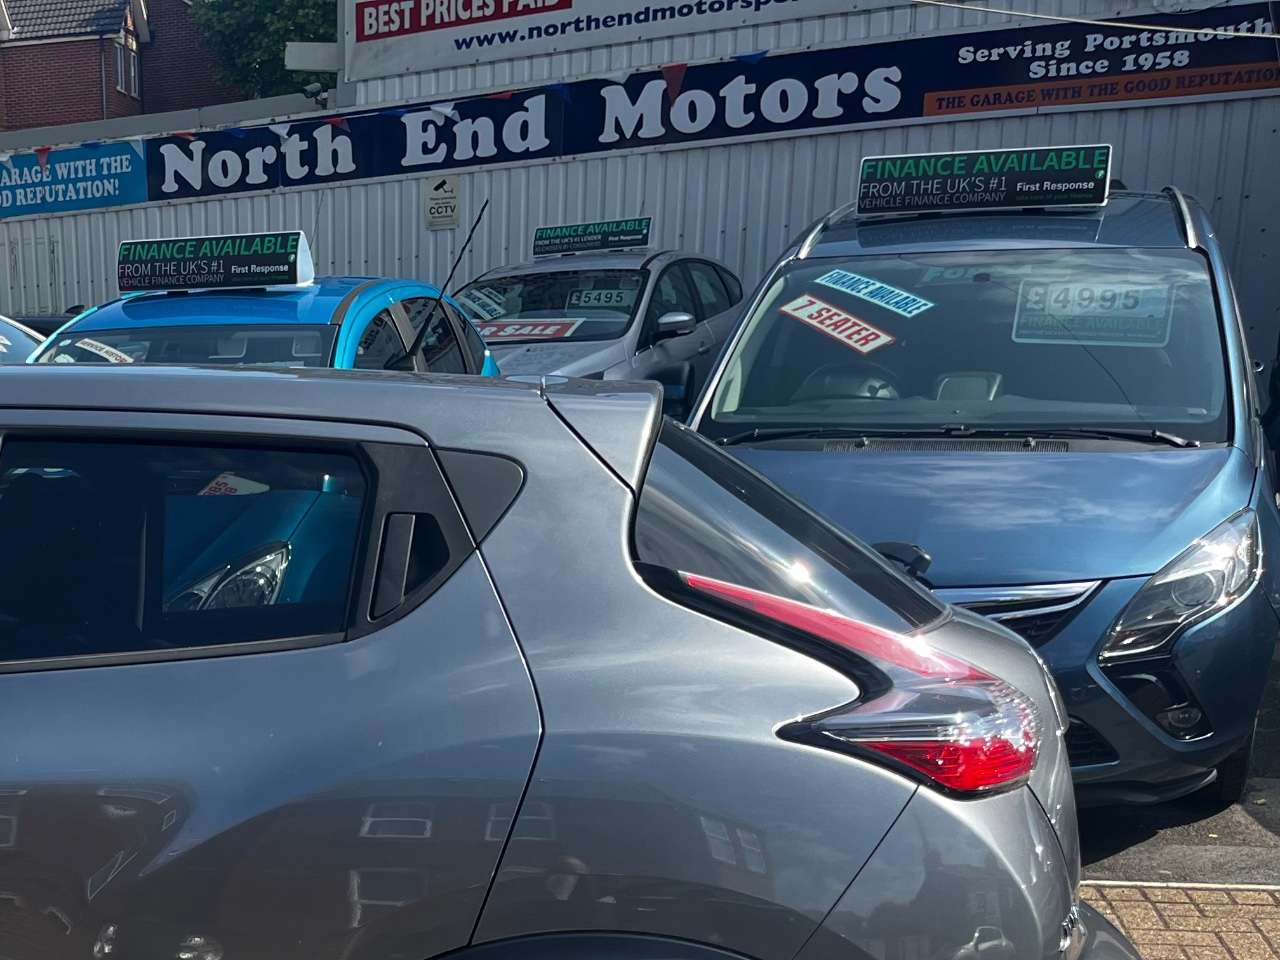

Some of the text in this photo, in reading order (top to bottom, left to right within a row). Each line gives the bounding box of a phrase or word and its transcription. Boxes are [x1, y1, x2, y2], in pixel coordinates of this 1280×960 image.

[363, 1, 415, 36] BEST
[420, 0, 495, 26] PRICES
[958, 17, 1273, 64] Serving Portsmouth
[1029, 50, 1190, 80] Since 1958
[936, 96, 966, 111] THE
[970, 91, 1036, 107] GARAGE
[1040, 86, 1084, 102] WITH
[1088, 83, 1119, 98] THE
[1124, 78, 1170, 95] GOOD
[160, 66, 902, 193] North End Motors
[55, 158, 97, 181] WITH
[100, 153, 132, 176] THE
[862, 148, 1108, 180] FINANCE AVAILABLE
[16, 178, 119, 207] REPUTATION!
[860, 176, 1007, 199] FROM THE UK'S #1
[860, 194, 902, 209] VEHICLE
[904, 192, 944, 207] FINANCE
[945, 190, 1007, 205] COMPANY
[1016, 180, 1096, 193] First Response
[429, 204, 456, 215] CCTV
[536, 219, 649, 240] FINANCE AVAILABLE
[121, 235, 299, 262] FINANCE AVAILABLE
[119, 259, 225, 278] FROM THE UK'S #1
[119, 275, 150, 288] VEHICLE
[152, 273, 185, 286] FINANCE
[186, 272, 225, 284] COMPANY
[231, 263, 289, 274] First Response
[571, 291, 624, 304] £5495
[824, 271, 929, 315] FINANCE AVAILABLE
[1026, 286, 1140, 311] £4995
[497, 325, 562, 336] SALE
[791, 299, 881, 347] 7 SEATER
